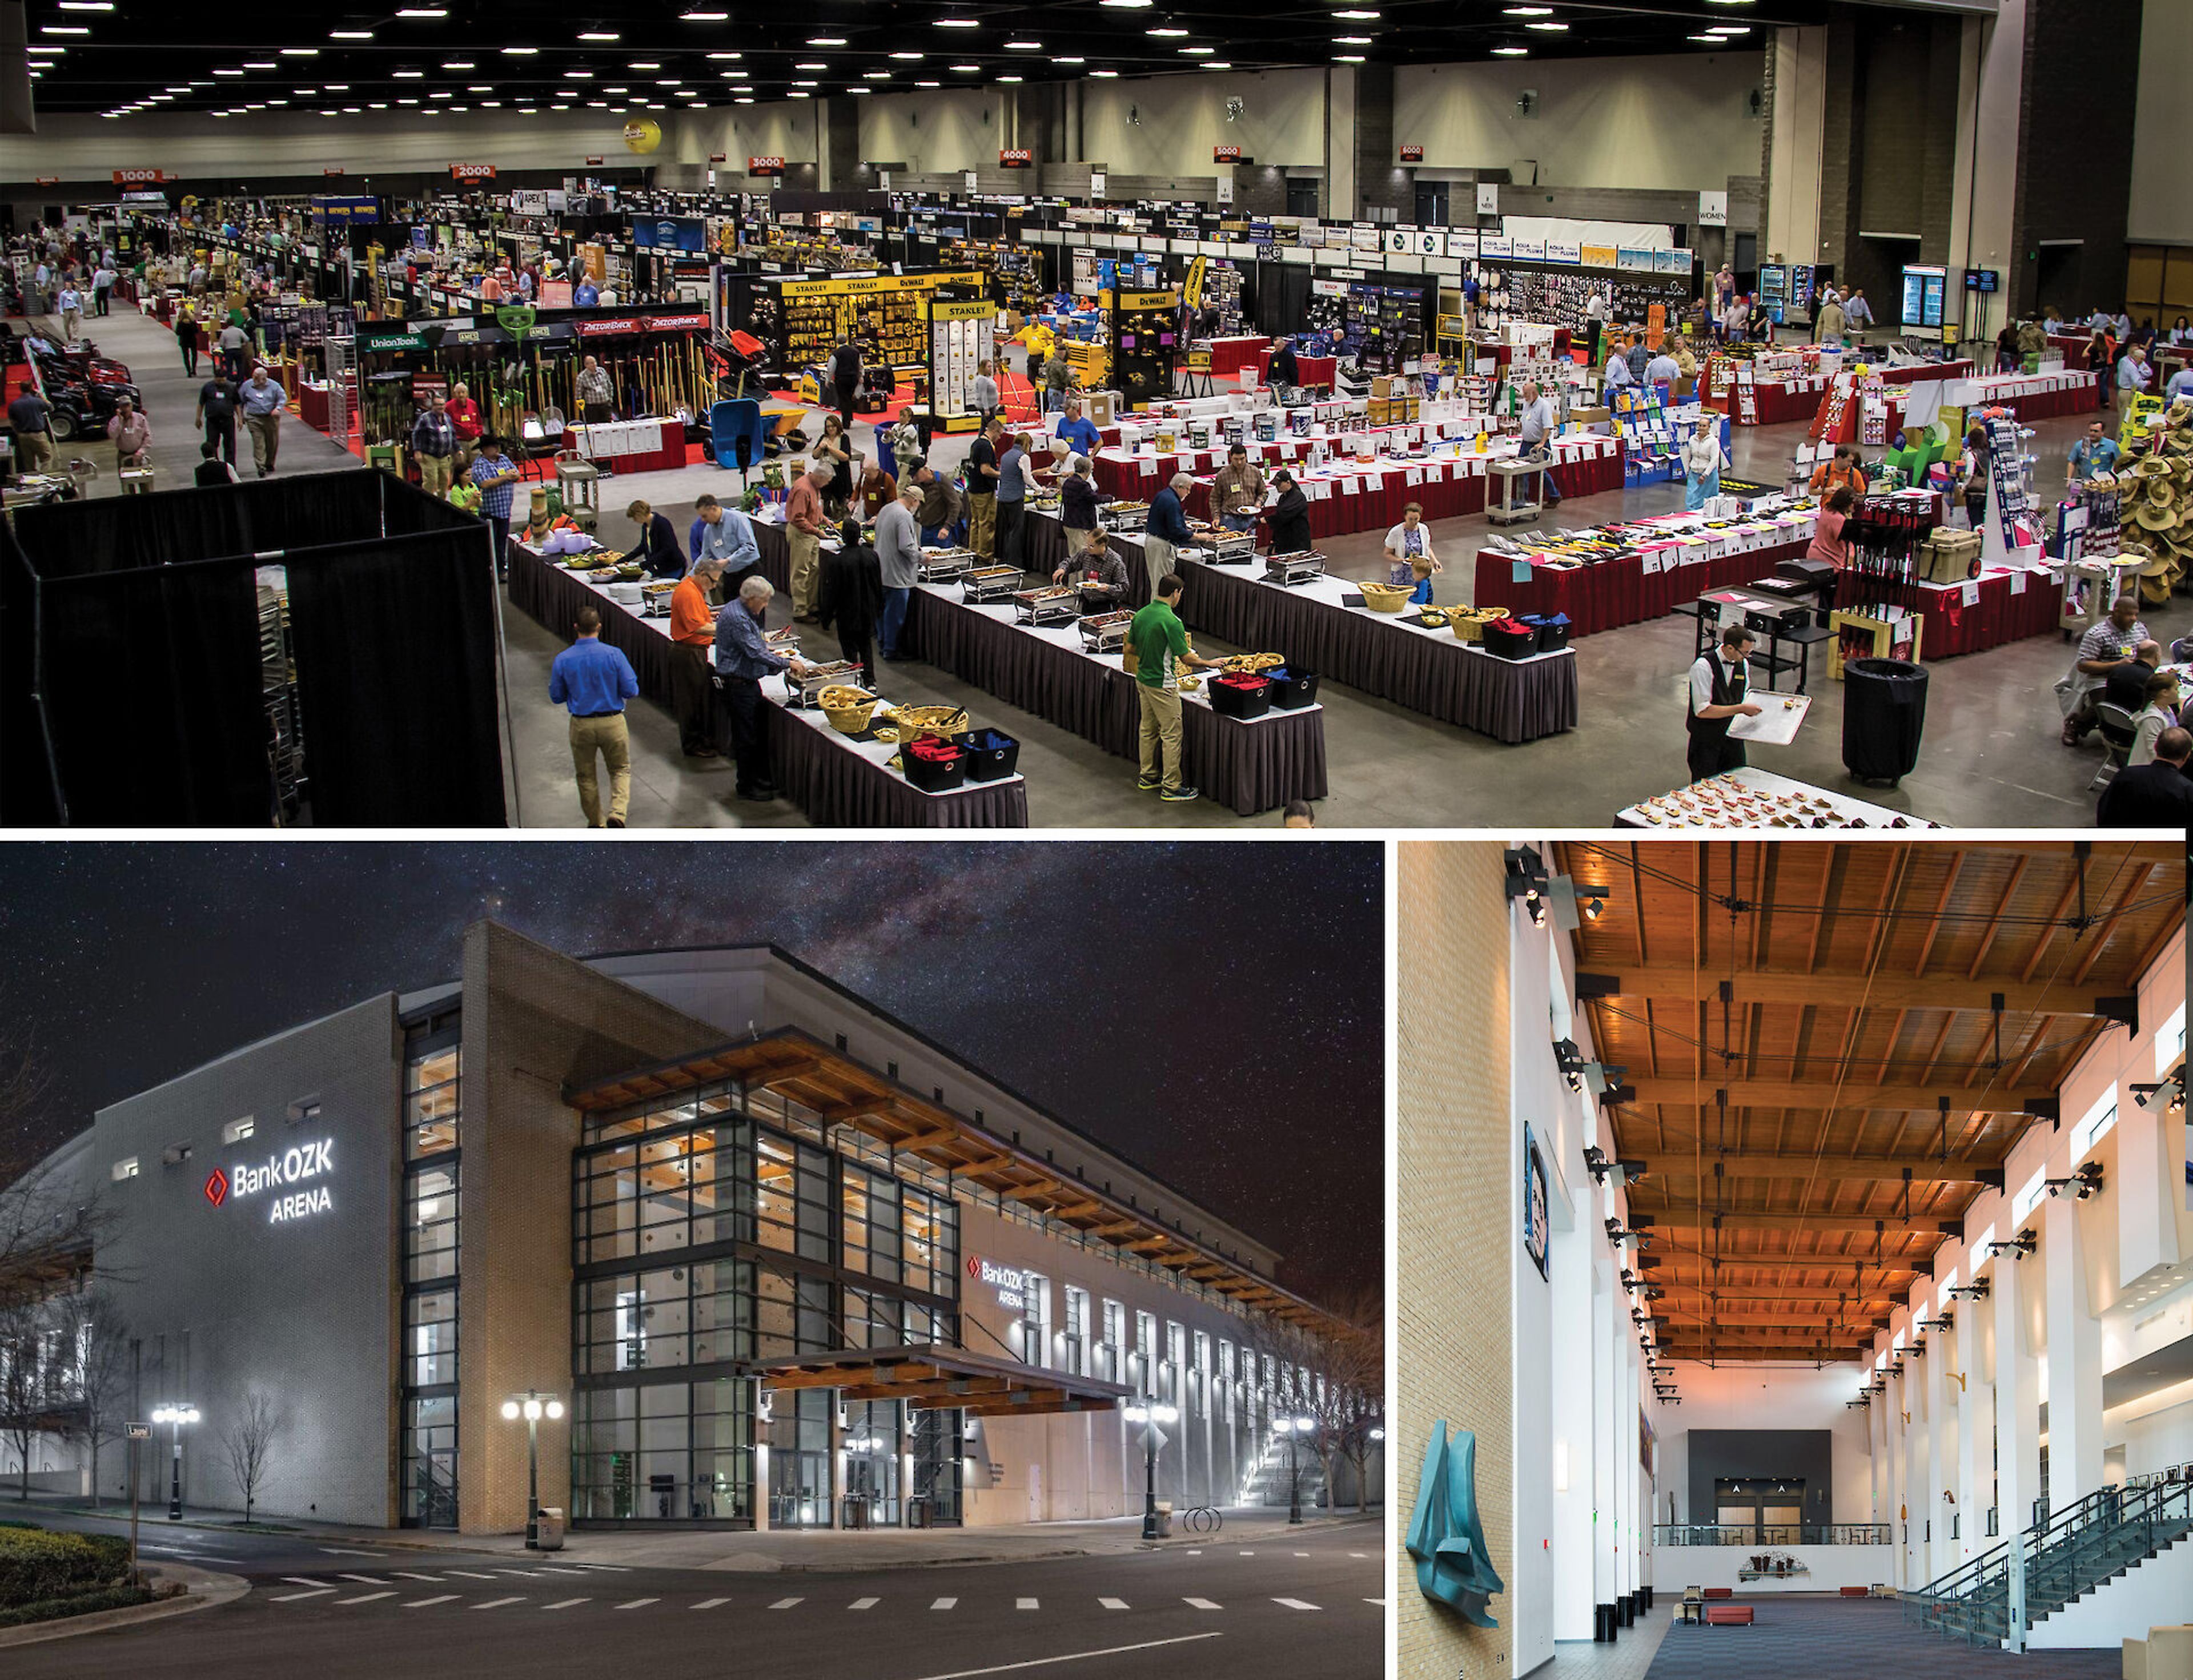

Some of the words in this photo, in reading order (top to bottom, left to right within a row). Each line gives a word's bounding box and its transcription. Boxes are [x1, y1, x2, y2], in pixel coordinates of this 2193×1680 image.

[1003, 150, 1028, 159] 4000
[753, 158, 780, 166] 3000
[121, 171, 155, 180] 1000
[459, 166, 491, 176] 2000
[949, 307, 986, 316] STANLEY
[371, 336, 420, 348] UnionTools
[233, 1155, 282, 1198] Bank
[283, 1138, 333, 1182] OZK
[270, 1187, 332, 1224] ARENA
[982, 1260, 1003, 1284] Bank
[1004, 1268, 1023, 1291] OZK
[998, 1289, 1023, 1308] ARENA
